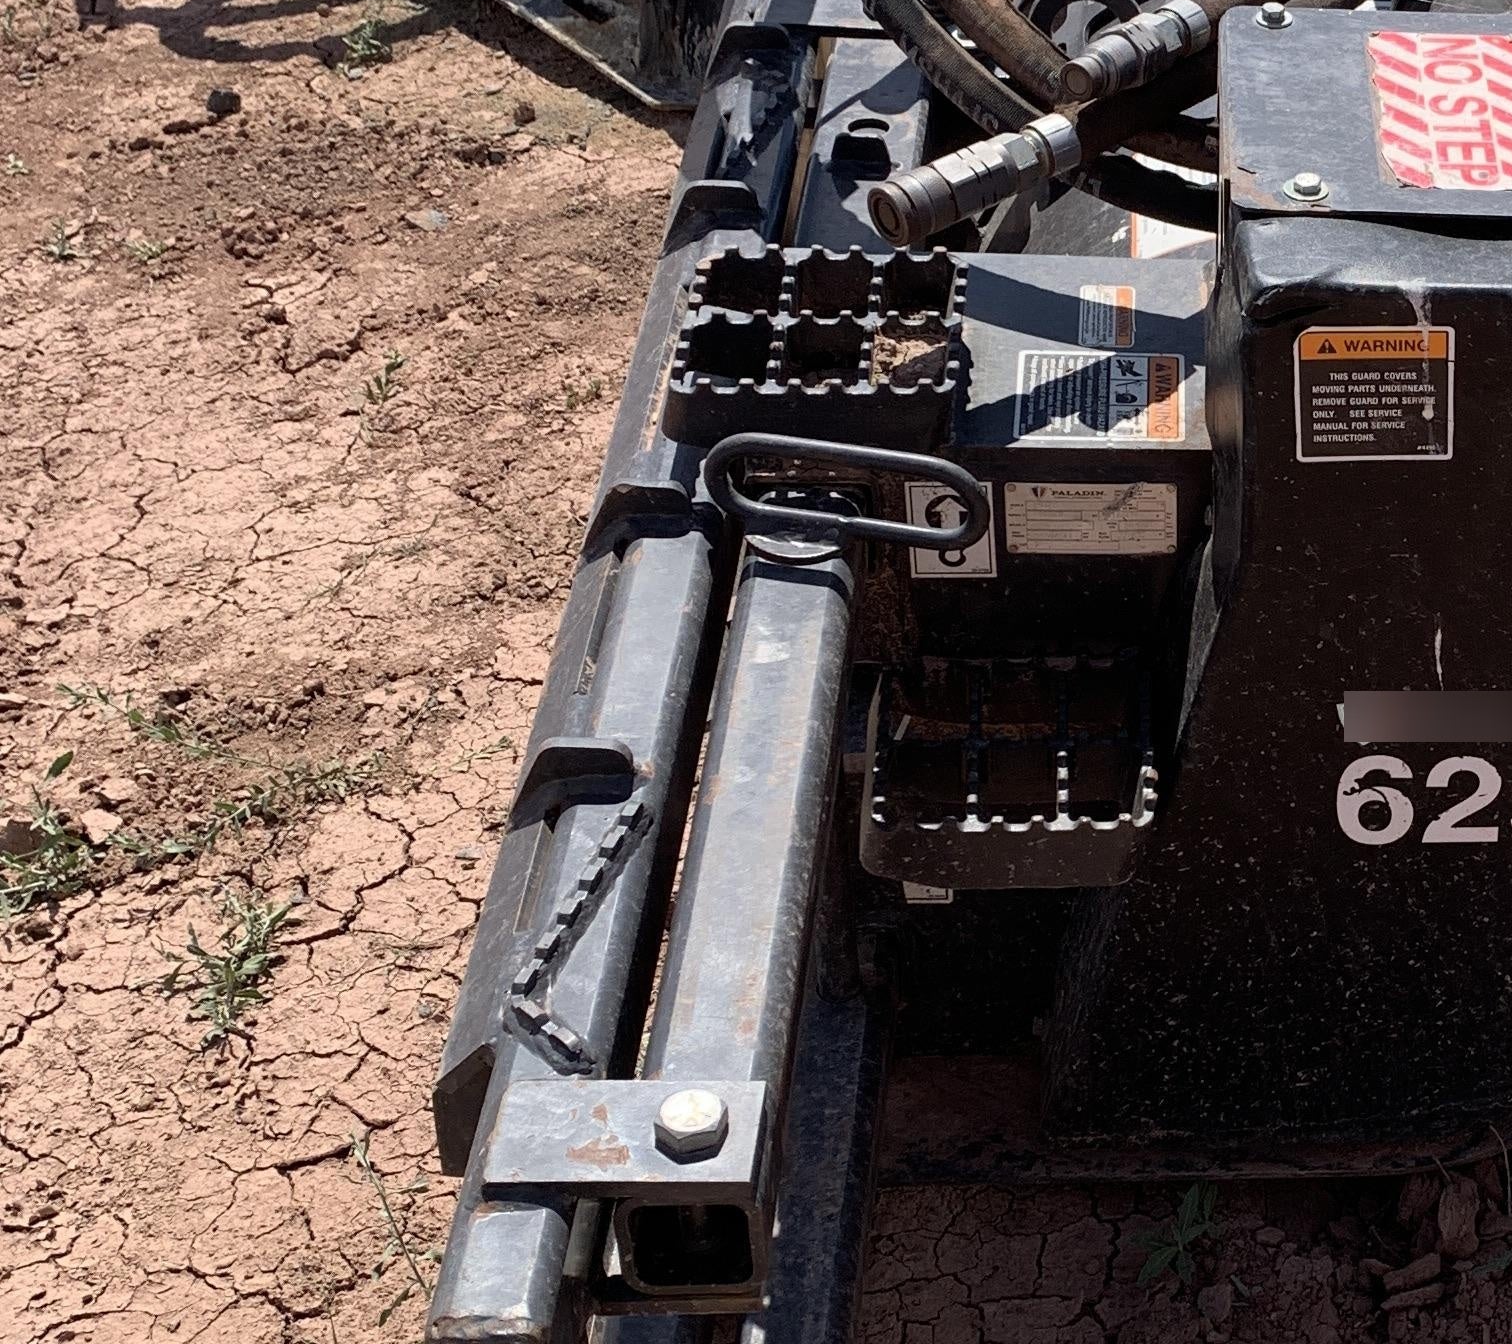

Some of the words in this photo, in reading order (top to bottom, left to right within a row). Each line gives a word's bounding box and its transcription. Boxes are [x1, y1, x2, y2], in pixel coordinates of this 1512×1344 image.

[1420, 37, 1483, 85] NO
[1429, 94, 1500, 186] STEP
[1329, 372, 1349, 381] THIS
[1351, 372, 1381, 380] GUARD
[1384, 371, 1418, 380] COVERS
[1311, 385, 1346, 394] MOVING
[1348, 385, 1376, 393] PARTS
[1154, 373, 1172, 433] WARNING
[1312, 397, 1347, 406] REMOVE
[1349, 397, 1379, 405] GUARD
[1382, 397, 1399, 405] FOR
[1401, 396, 1436, 405] SERVICE
[1349, 409, 1366, 418] SEE
[1367, 409, 1403, 418] SERVICE
[1313, 422, 1349, 431] MANUAL
[1351, 421, 1369, 430] FOR
[1371, 421, 1406, 429] SERVICE
[1313, 433, 1377, 443] INSTRUCTIONS.
[1051, 489, 1105, 497] PALADIN
